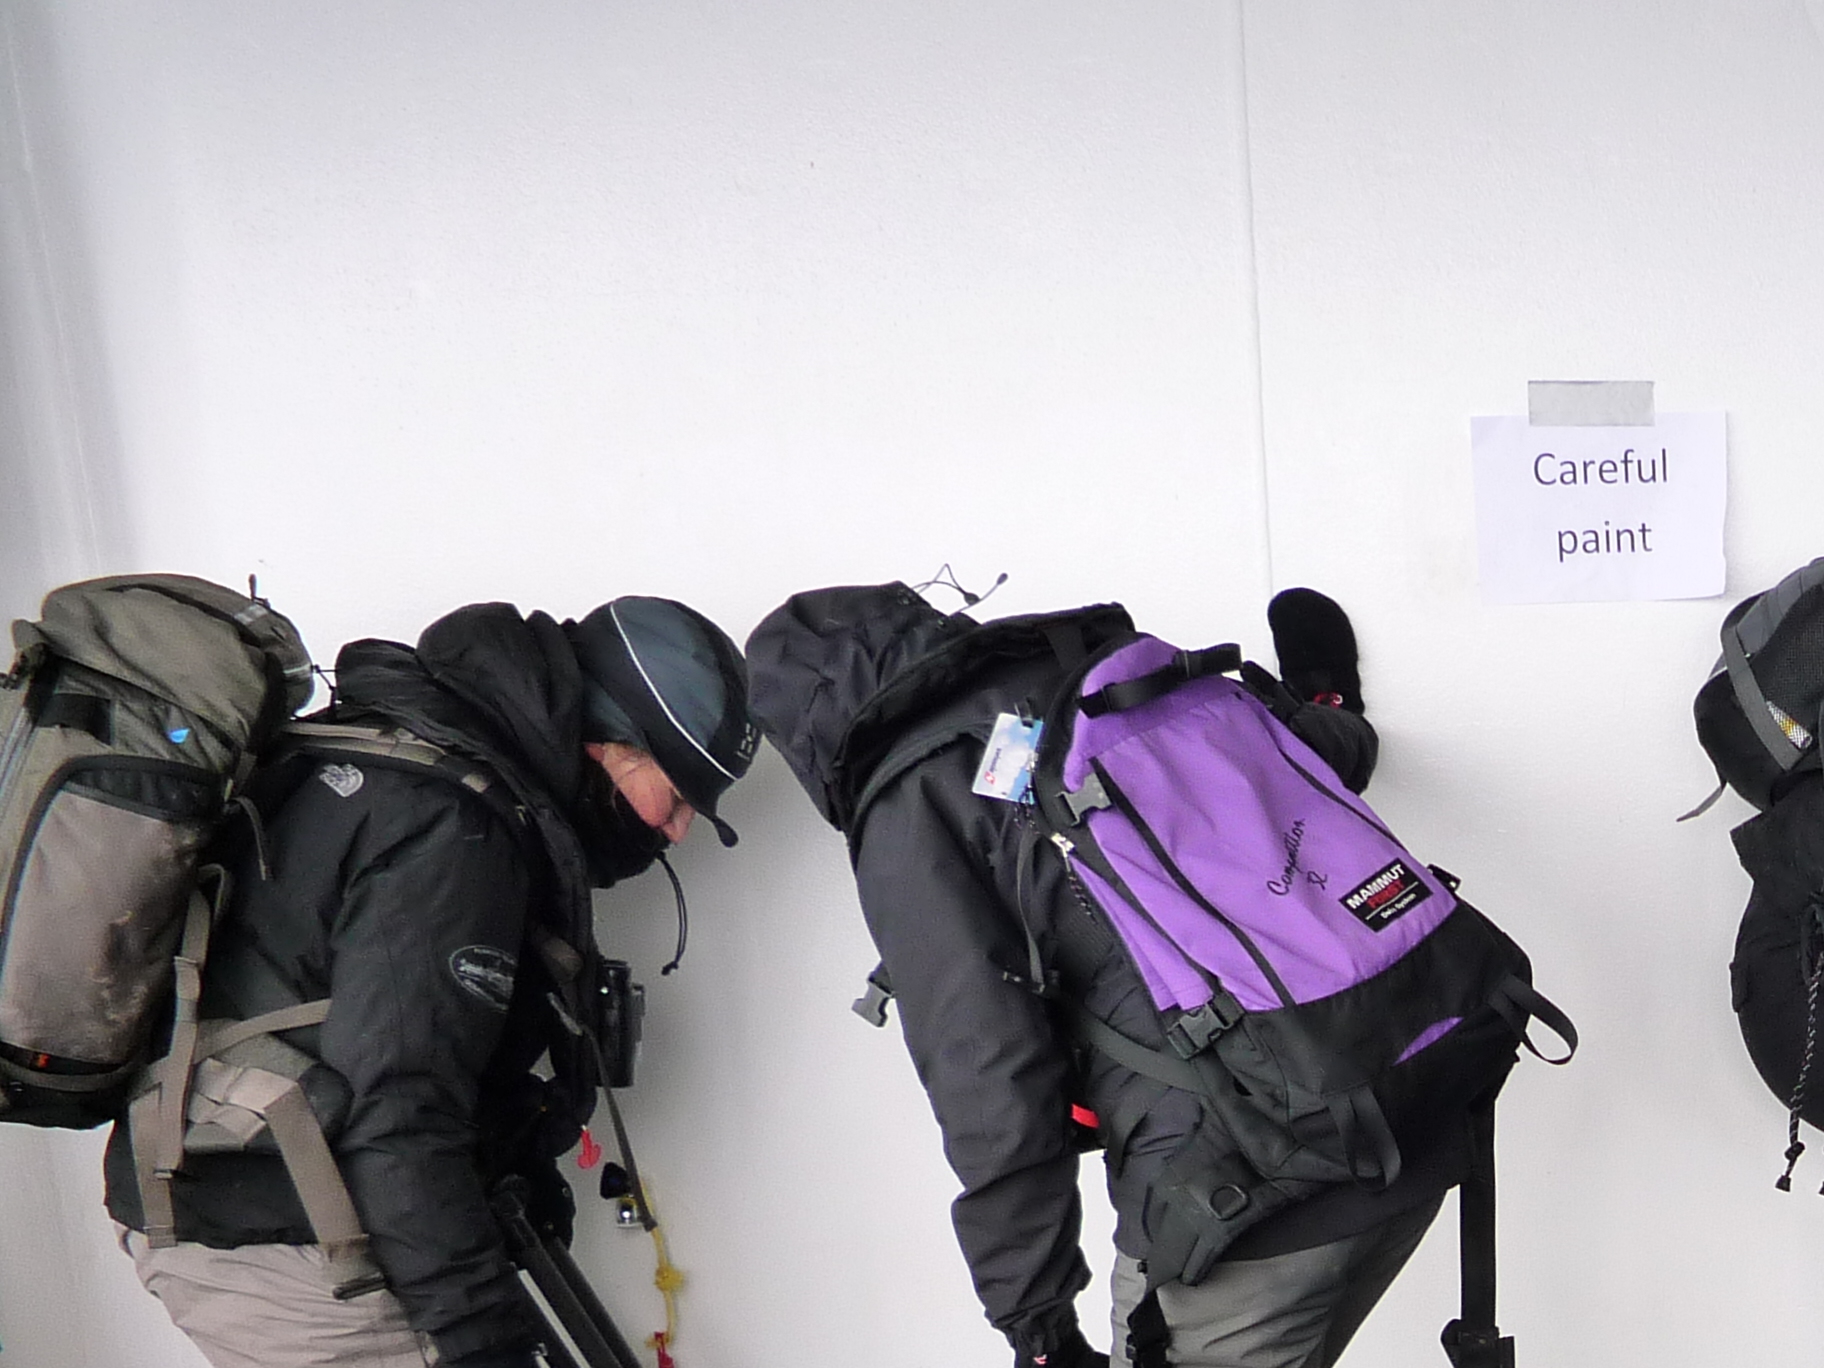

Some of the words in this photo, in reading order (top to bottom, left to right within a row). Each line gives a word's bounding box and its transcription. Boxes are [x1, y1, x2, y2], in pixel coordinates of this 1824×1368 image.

[1533, 448, 1667, 485] Careful
[1558, 521, 1653, 563] paint
[1346, 864, 1405, 909] MAMMUT
